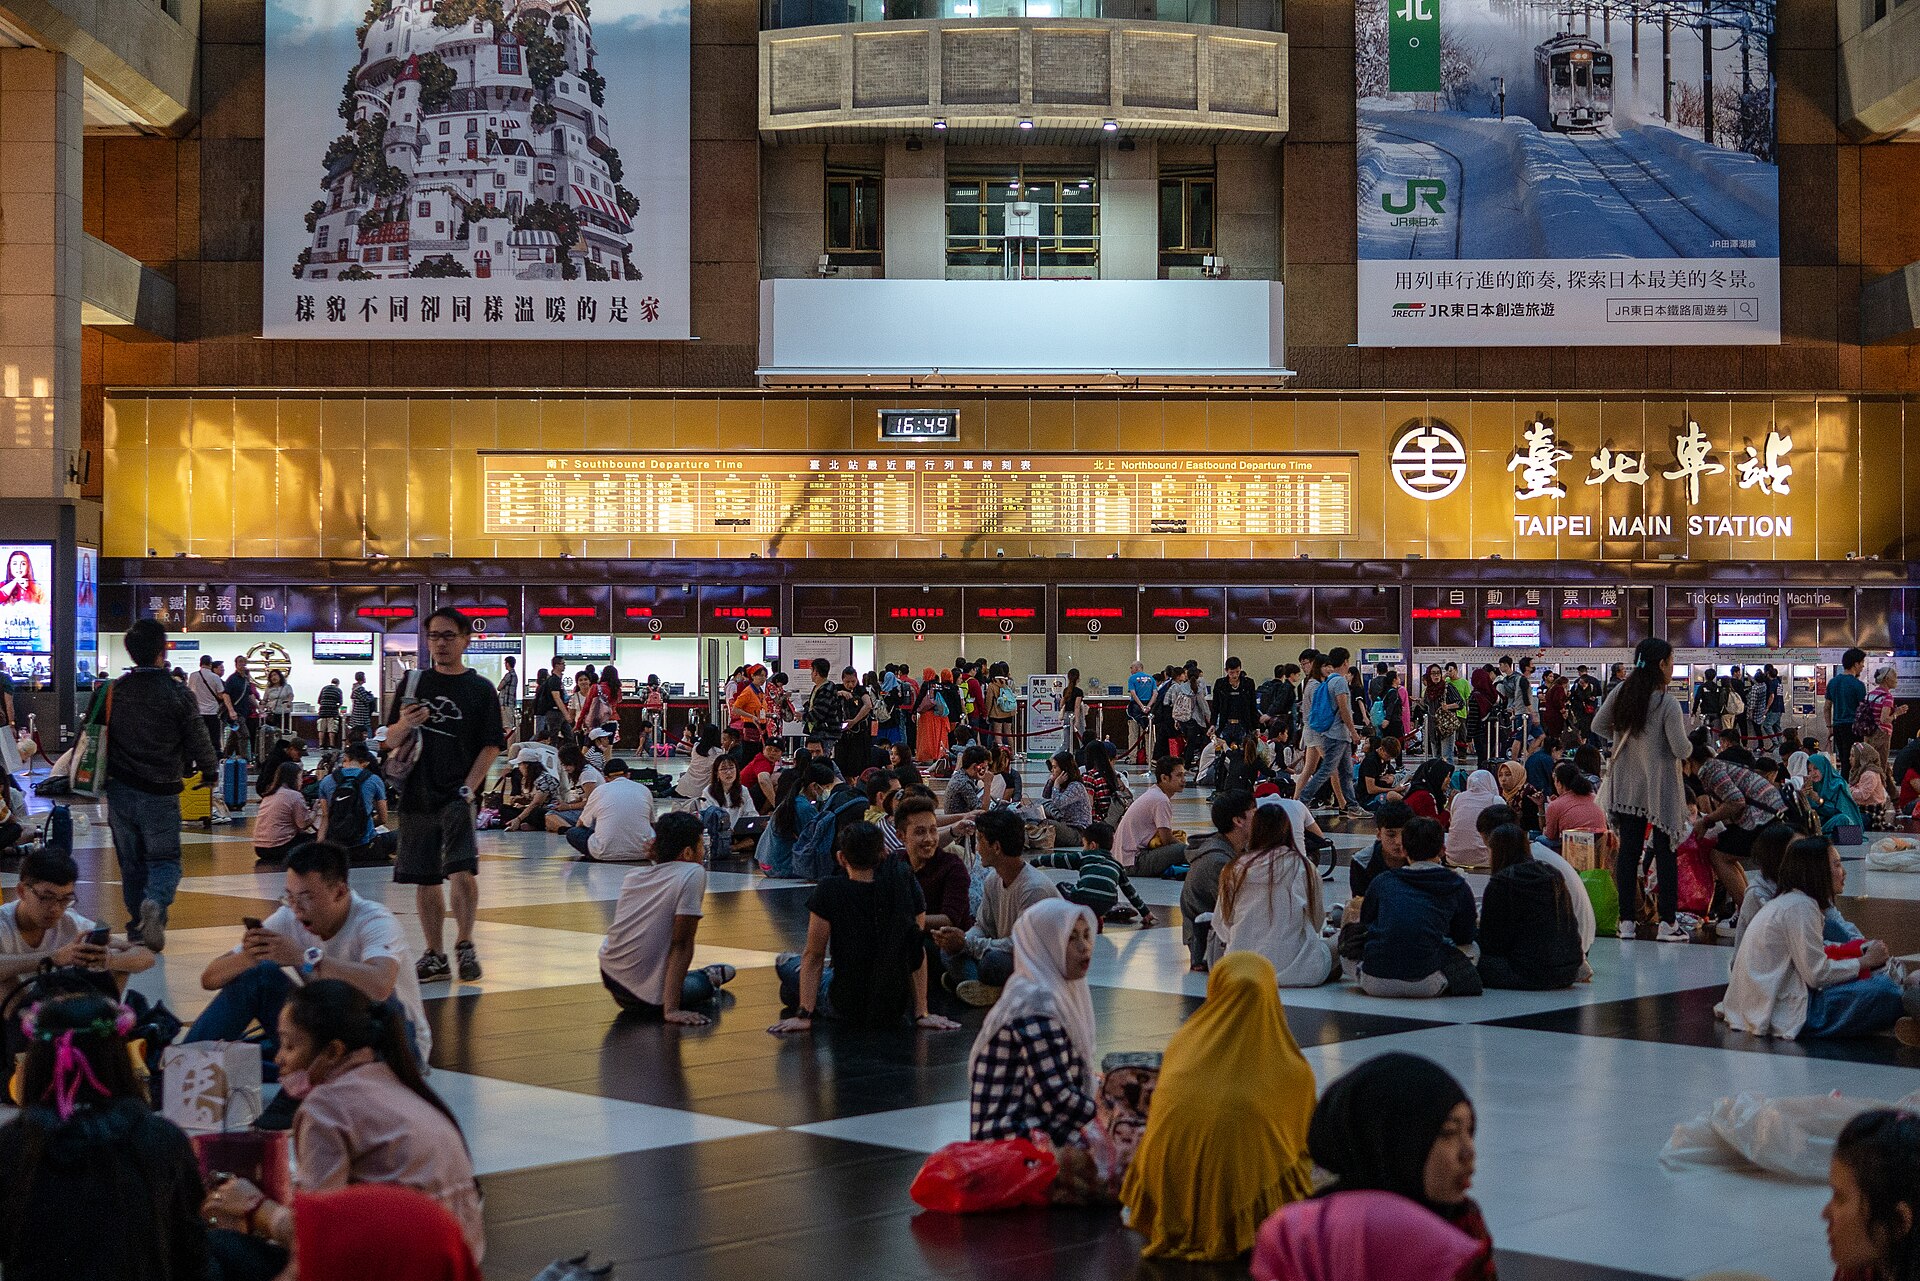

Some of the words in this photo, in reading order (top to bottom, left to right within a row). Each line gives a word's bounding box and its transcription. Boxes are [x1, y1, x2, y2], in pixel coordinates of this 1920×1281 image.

[1382, 179, 1447, 214] JR
[1390, 217, 1439, 227] JR東日本
[1391, 310, 1426, 318] JRECTT
[1428, 302, 1555, 318] JR東日本創造旅遊
[1614, 304, 1728, 317] JR東日本鐵路周遊券
[896, 417, 949, 434] 16:49
[546, 459, 568, 469] 南下
[574, 459, 646, 469] Southbound
[650, 459, 710, 471] Departure
[715, 459, 743, 469] Time
[809, 459, 1032, 471] 臺北站最近開行列車時刻表
[1094, 460, 1116, 470] 北上
[1121, 460, 1178, 470] Northbound
[1186, 460, 1236, 470] Eastbound
[1239, 460, 1286, 471] Departure
[1289, 460, 1313, 470] Time
[1507, 421, 1793, 505] 臺北車站
[1514, 516, 1591, 536] TAIPEI
[1608, 516, 1671, 536] MAIN
[1688, 516, 1792, 537] STATION
[1449, 589, 1617, 605] 自動售票機
[1685, 592, 1730, 604] Tickets
[1736, 592, 1780, 606] Vending
[1787, 592, 1831, 604] Machine
[201, 612, 266, 623] Information
